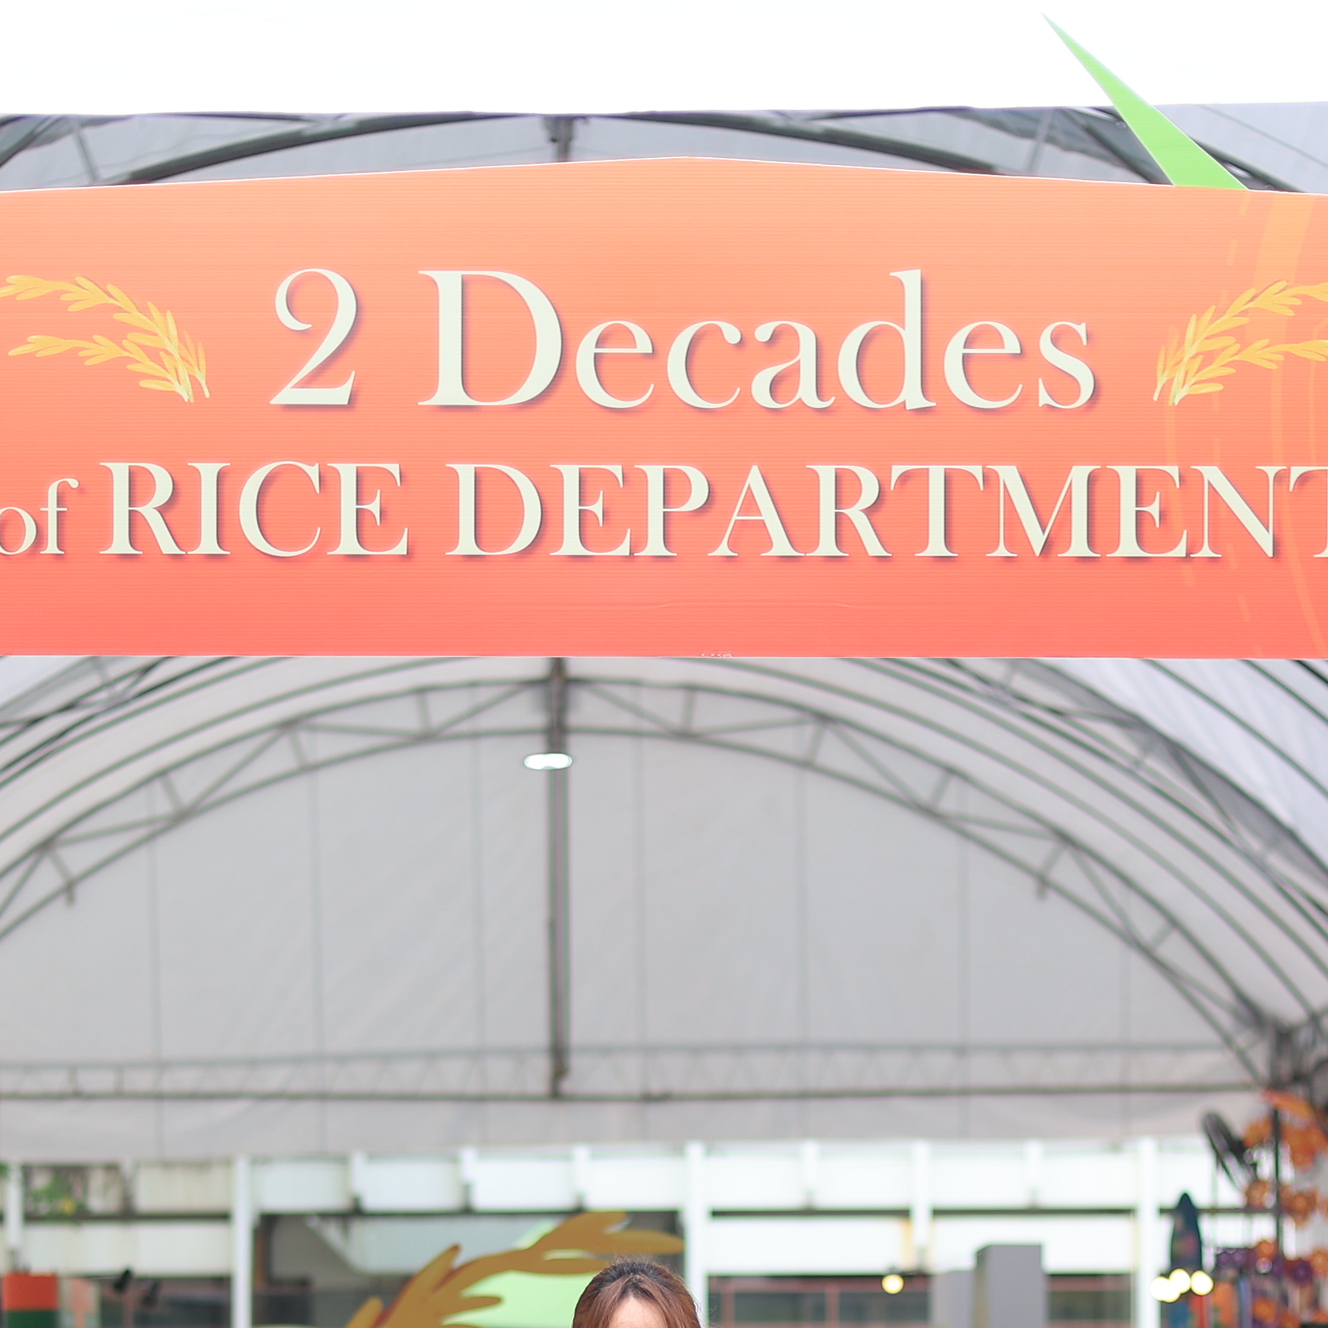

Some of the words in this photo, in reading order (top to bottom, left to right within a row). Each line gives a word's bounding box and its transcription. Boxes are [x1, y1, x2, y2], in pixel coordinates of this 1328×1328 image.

[269, 268, 358, 406] 2
[418, 268, 1097, 410] Decades
[99, 460, 409, 558] RICE
